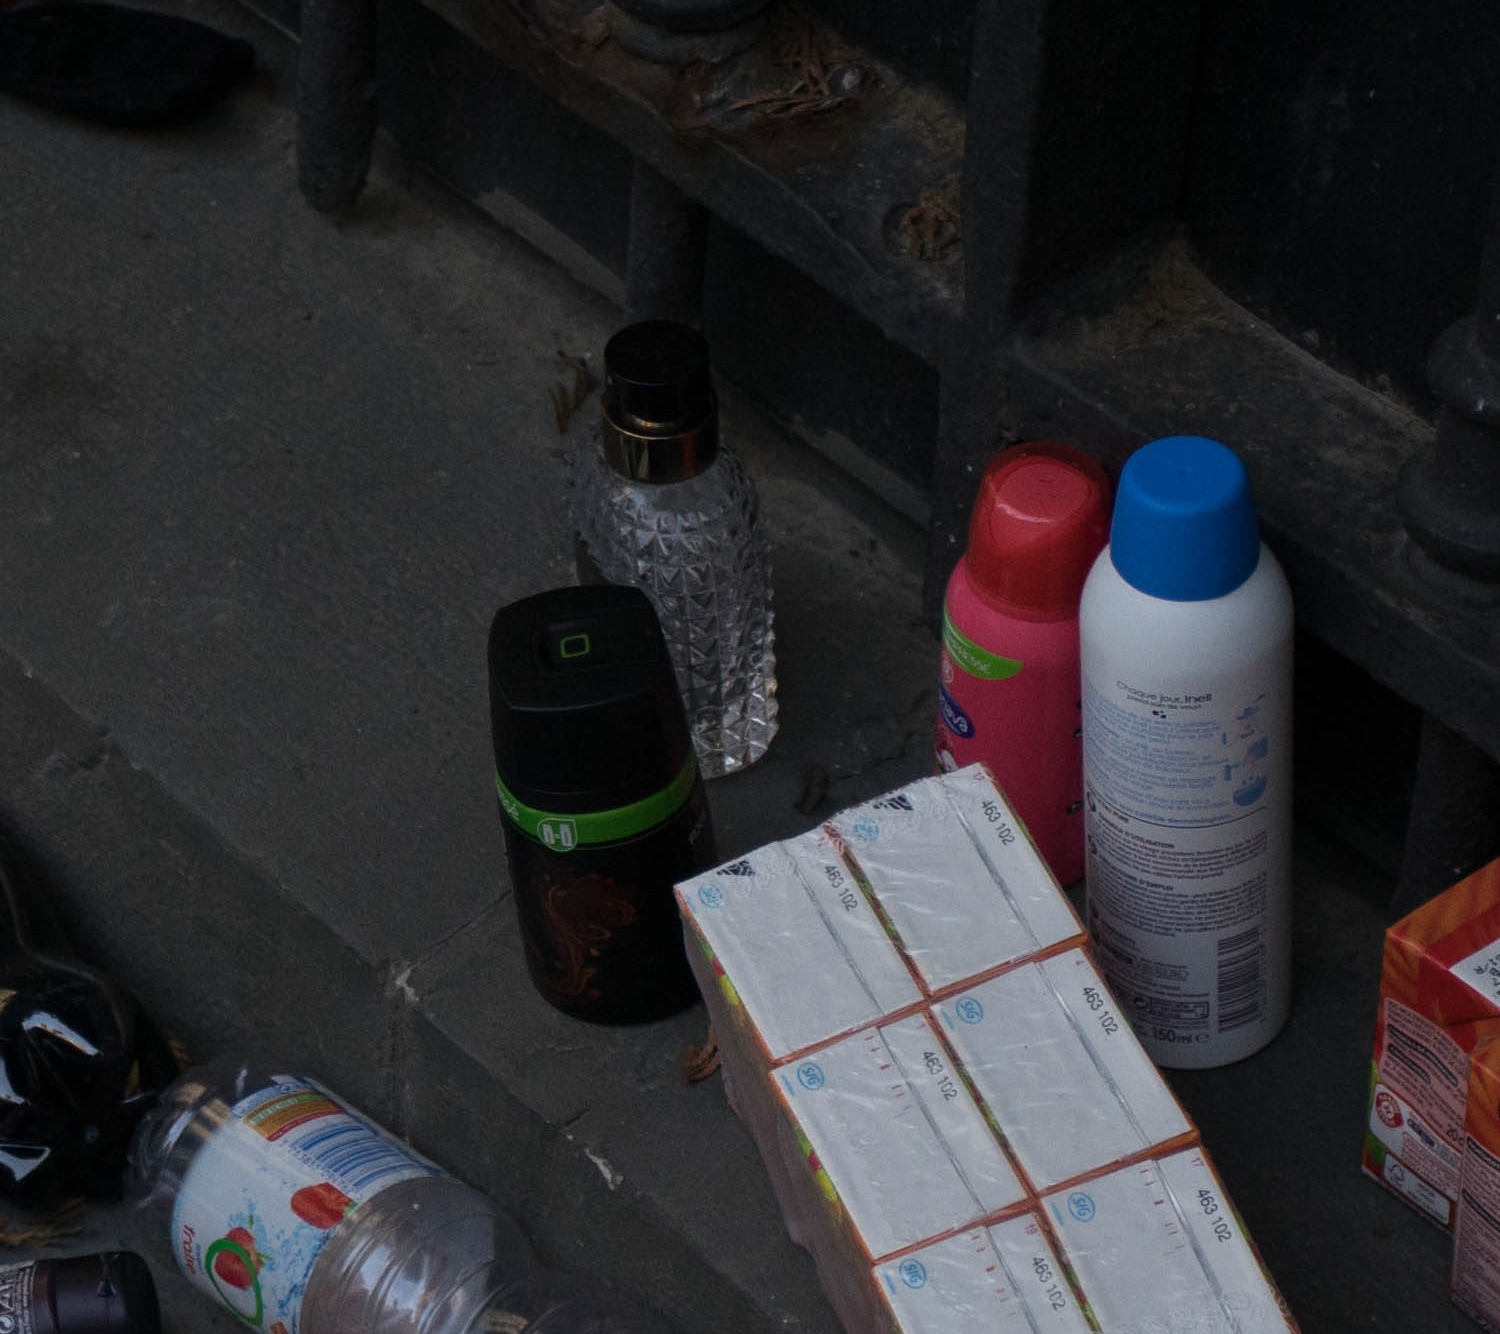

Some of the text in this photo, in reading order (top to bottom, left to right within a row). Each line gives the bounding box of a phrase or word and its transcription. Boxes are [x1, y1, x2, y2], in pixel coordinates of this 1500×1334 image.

[1116, 680, 1158, 702] Chaque
[981, 798, 1017, 847] 463 102
[823, 864, 859, 913] 463 102
[1082, 985, 1120, 1037] 463 102
[923, 1051, 959, 1101] 463 102
[1198, 1187, 1233, 1243] 463 102
[1031, 1256, 1067, 1312] 463 102
